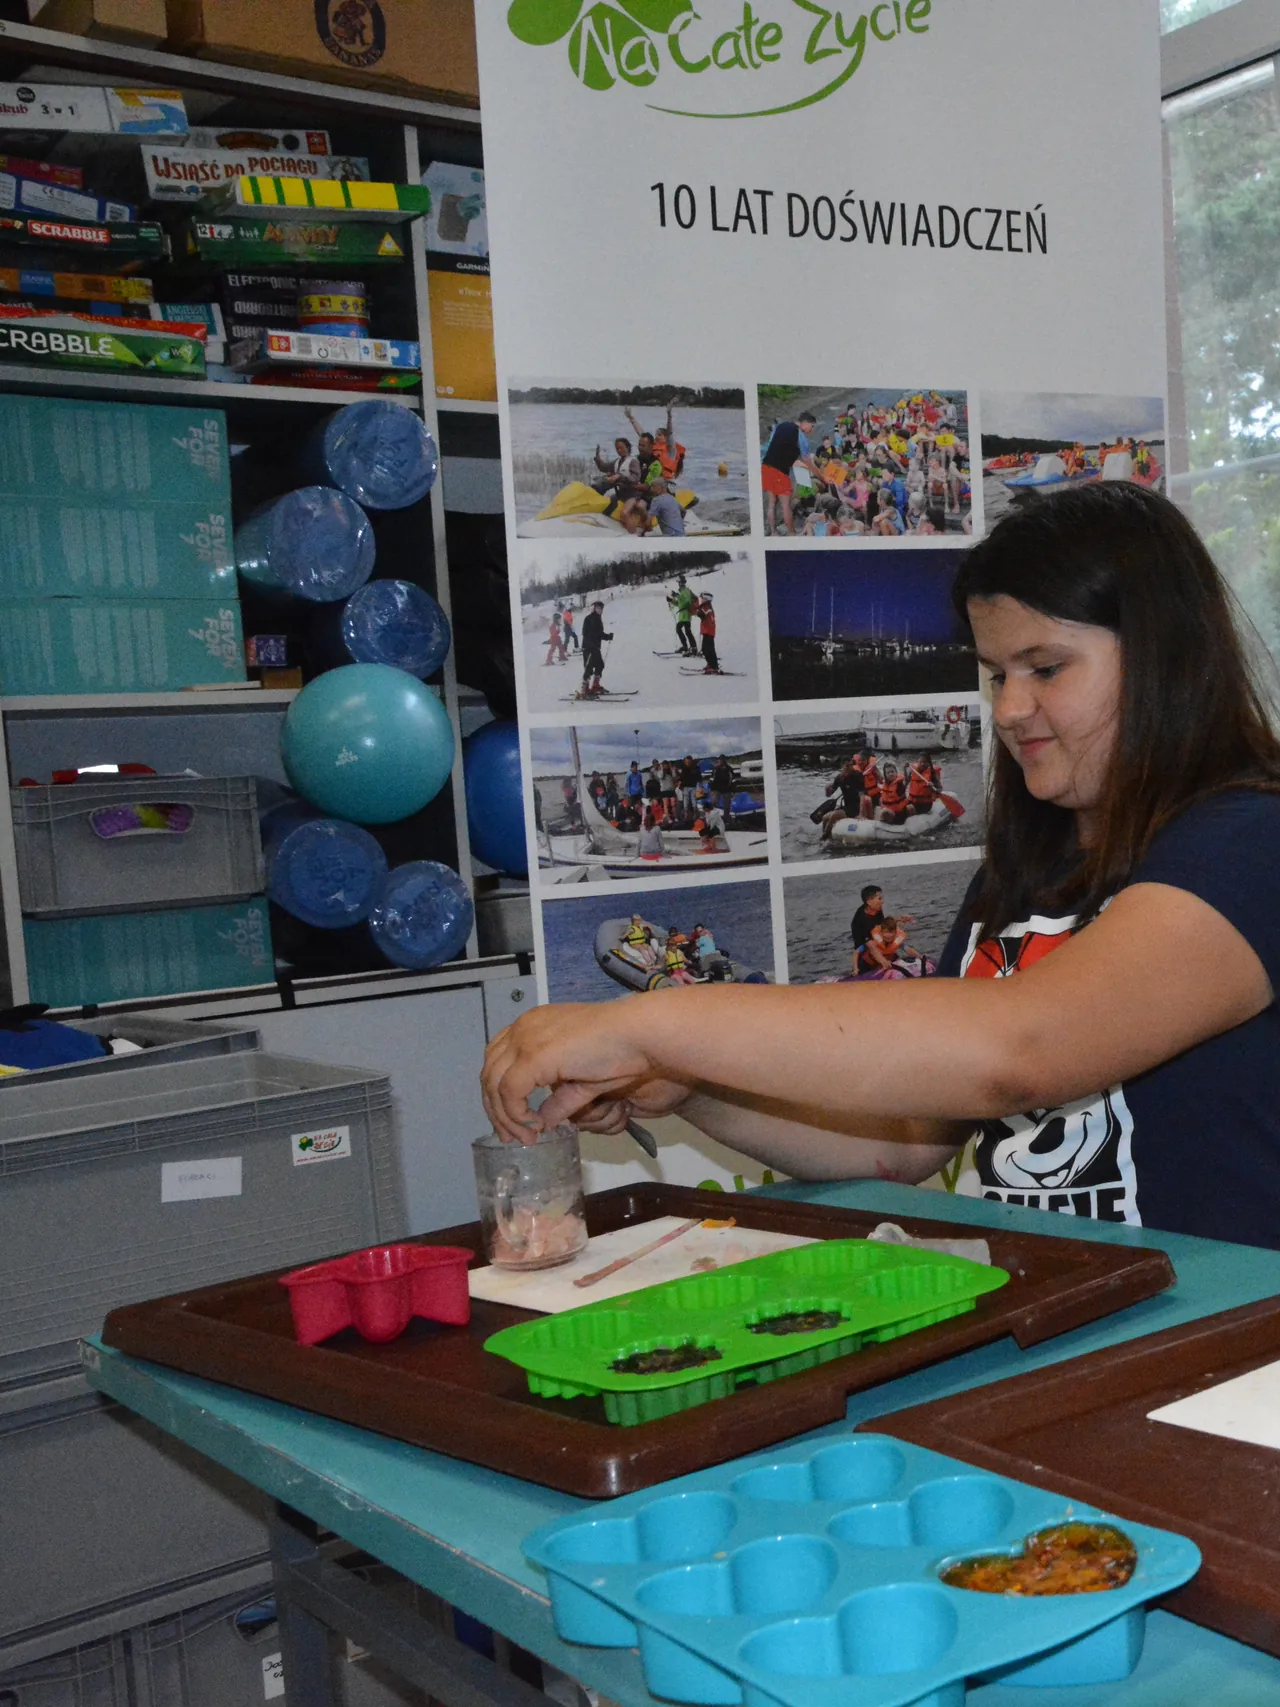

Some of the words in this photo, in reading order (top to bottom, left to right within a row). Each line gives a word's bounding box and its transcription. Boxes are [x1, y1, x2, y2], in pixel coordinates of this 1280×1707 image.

[578, 15, 660, 81] Na
[41, 104, 50, 115] 3
[650, 181, 698, 231] 10
[710, 185, 774, 236] LAT
[786, 189, 1048, 255] DOŚWIADCZEŃ
[31, 223, 109, 242] SCRABBLE
[456, 261, 490, 273] GARMIN
